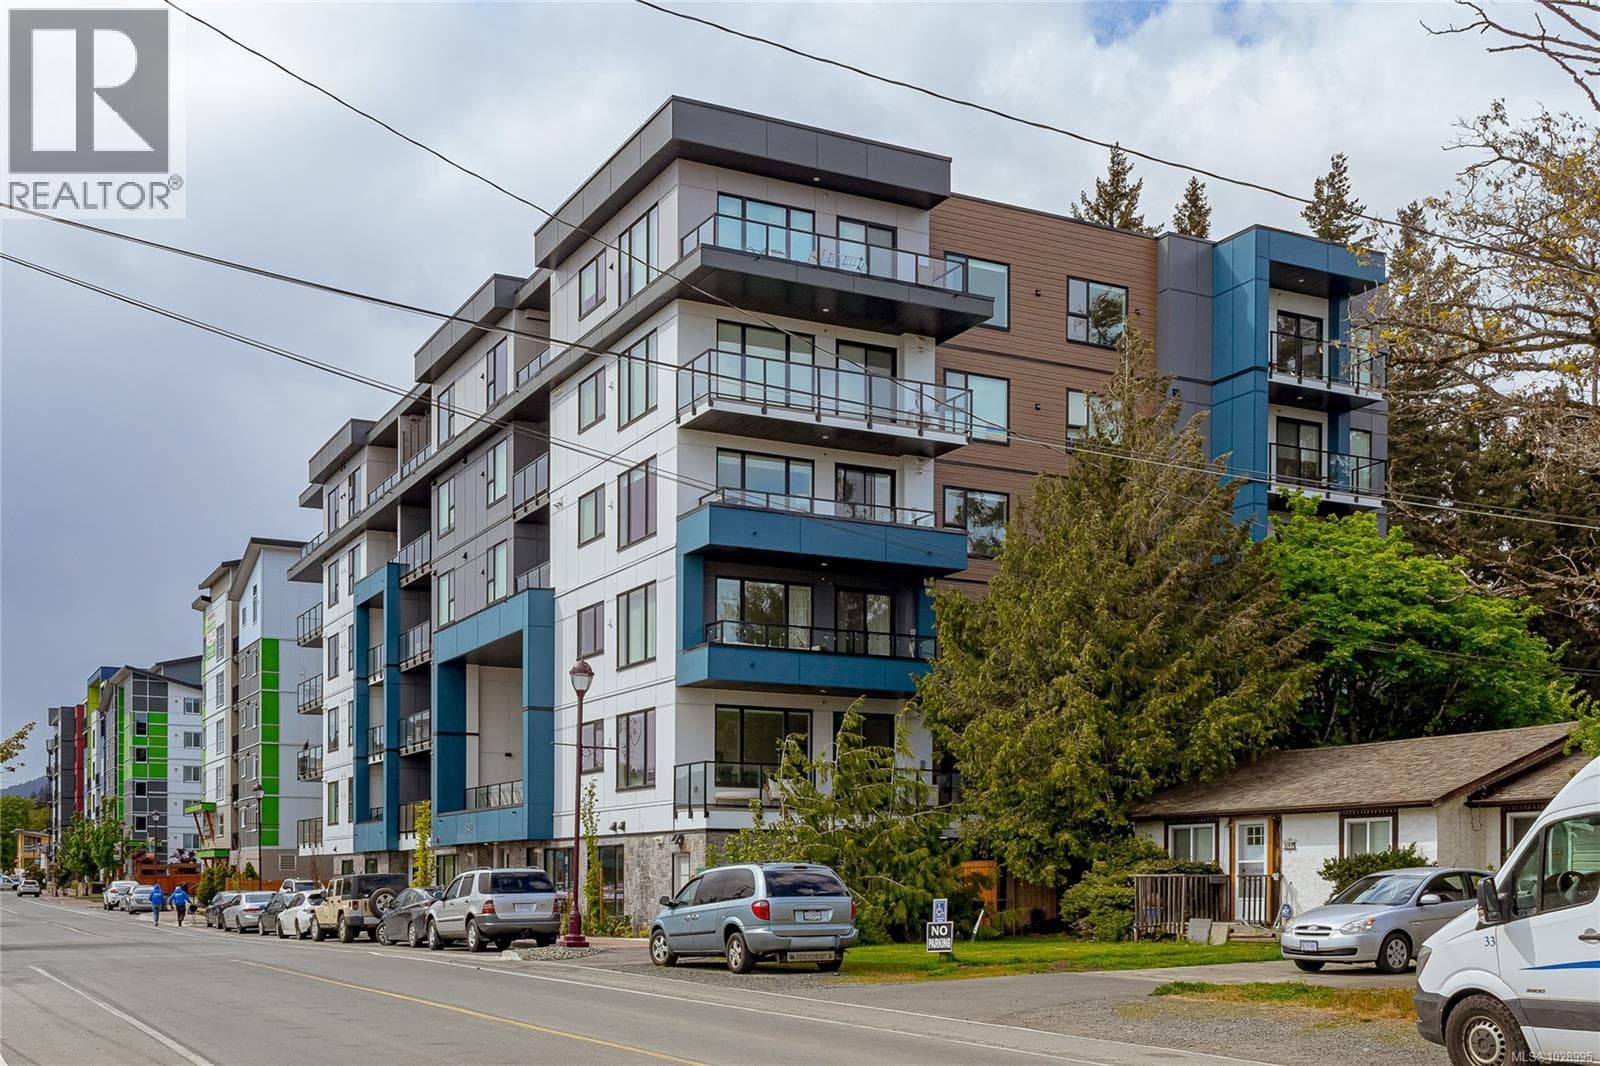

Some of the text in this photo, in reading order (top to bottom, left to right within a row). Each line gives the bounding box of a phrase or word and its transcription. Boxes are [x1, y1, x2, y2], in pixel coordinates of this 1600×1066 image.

[931, 925, 948, 936] NO
[928, 937, 951, 949] PARKING
[1484, 936, 1496, 947] 33
